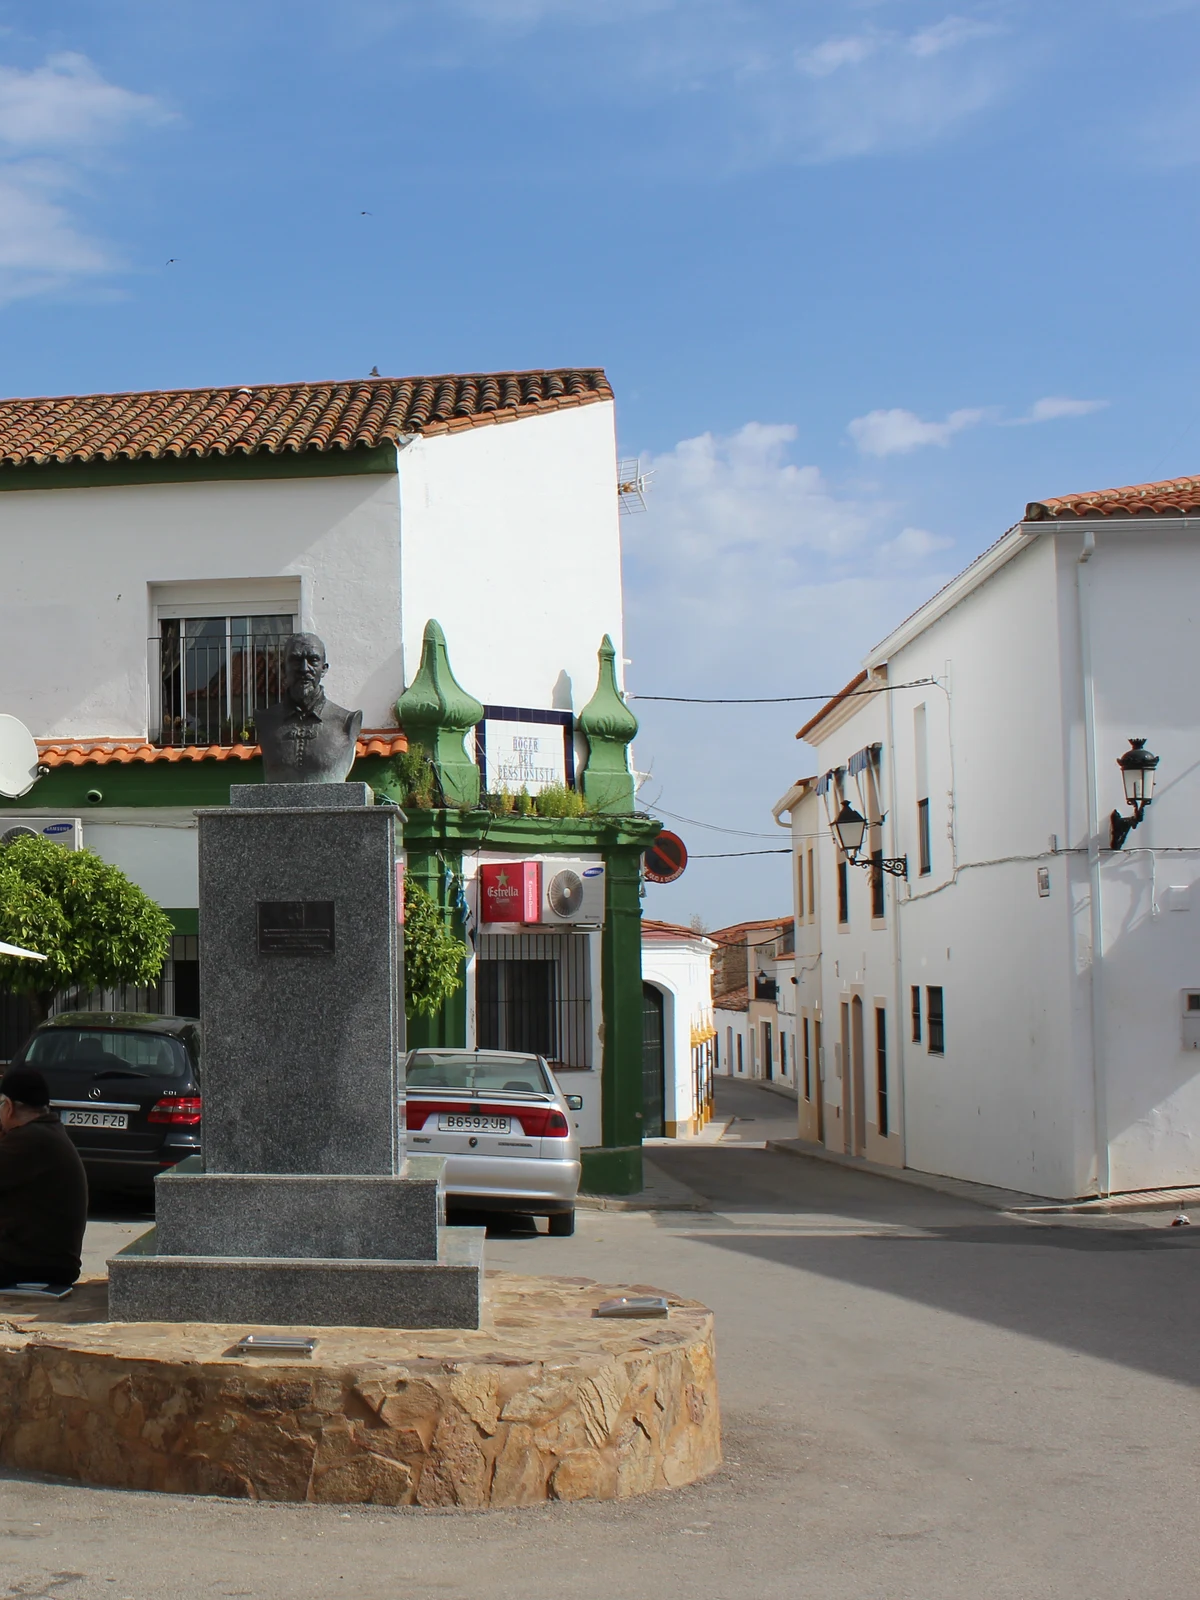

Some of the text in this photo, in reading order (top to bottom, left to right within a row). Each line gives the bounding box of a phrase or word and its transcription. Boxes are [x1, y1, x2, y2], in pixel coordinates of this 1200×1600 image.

[513, 736, 539, 752] HOGAR
[519, 751, 533, 767] DEL
[487, 886, 519, 897] Estrella
[68, 1112, 125, 1127] 2576 FZB
